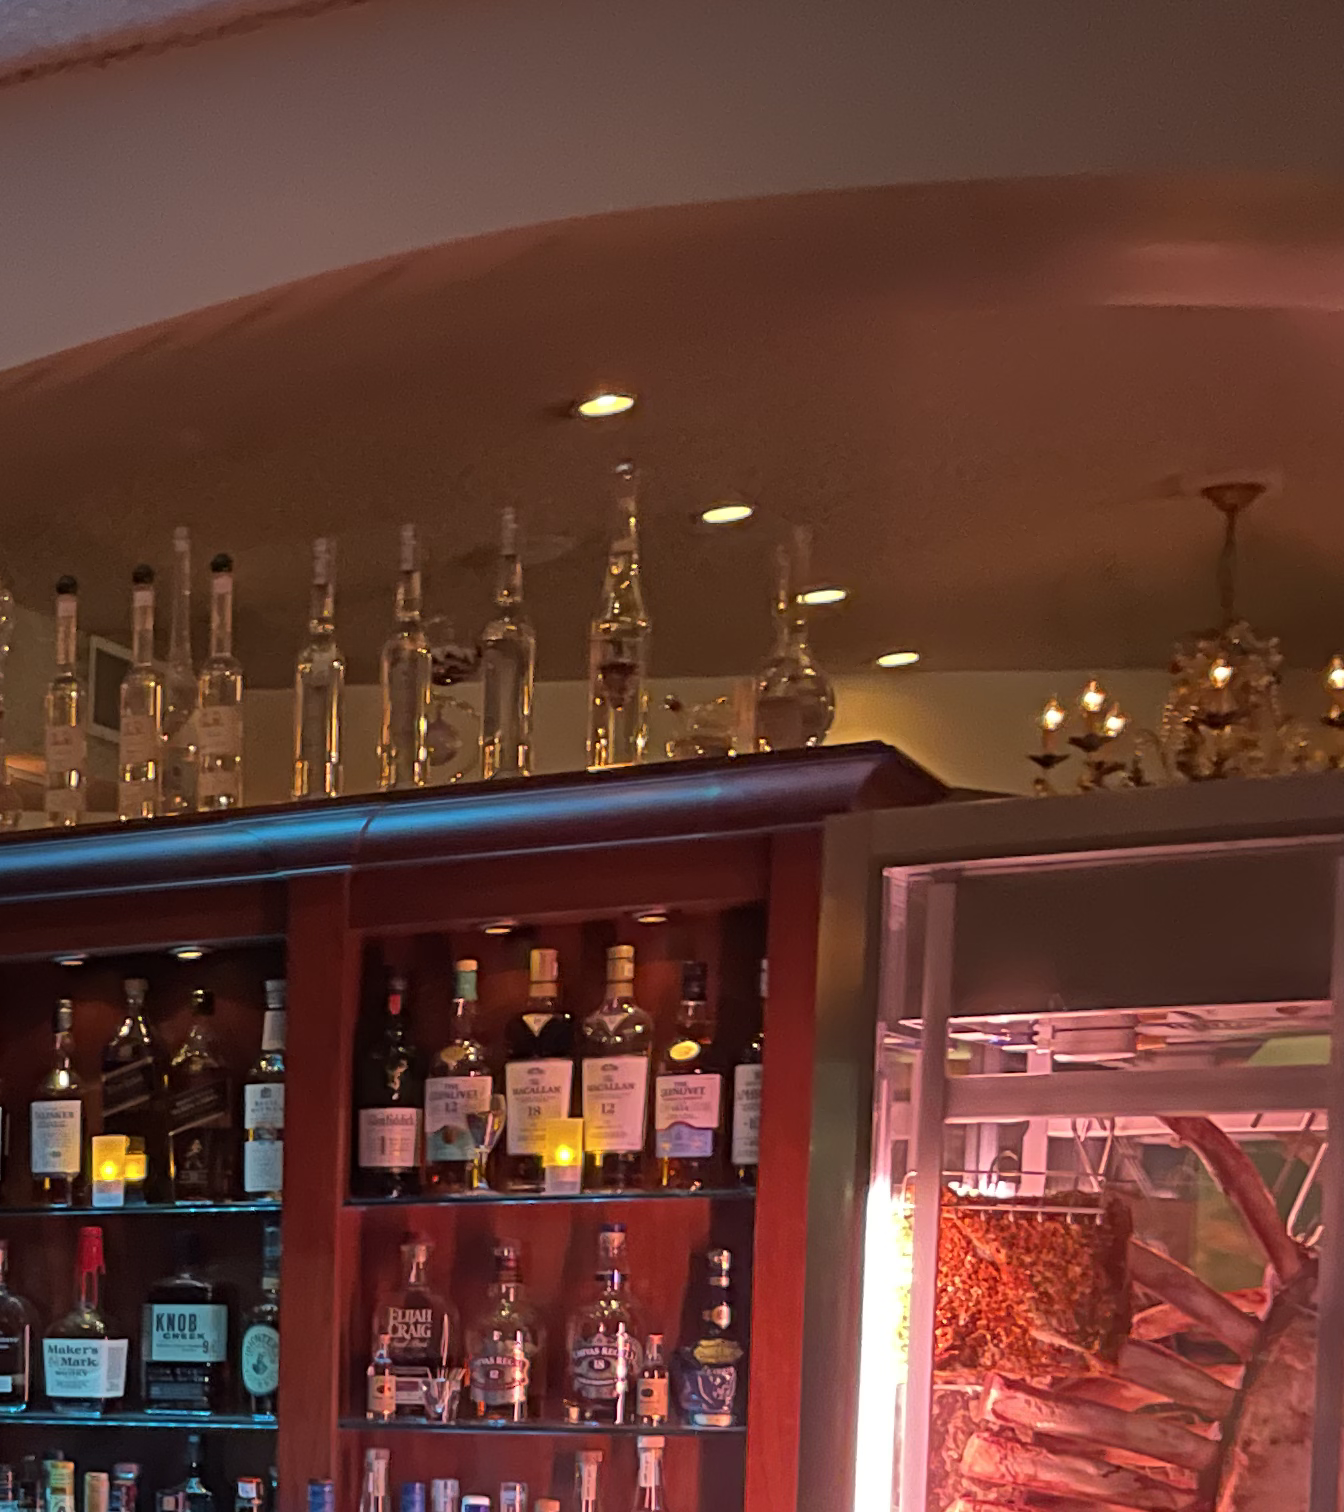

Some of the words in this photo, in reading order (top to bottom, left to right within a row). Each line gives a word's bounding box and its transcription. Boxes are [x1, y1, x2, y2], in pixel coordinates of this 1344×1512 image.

[512, 1085, 562, 1095] MACALLAN
[587, 1083, 636, 1092] MACALLAN
[444, 1101, 459, 1113] 12
[527, 1105, 542, 1116] 18
[601, 1103, 615, 1115] 12
[388, 1307, 433, 1323] ELIJAH
[155, 1312, 197, 1332] KNOB
[162, 1332, 206, 1340] CREEK
[388, 1323, 433, 1339] CRAIG
[47, 1344, 99, 1355] Maker's
